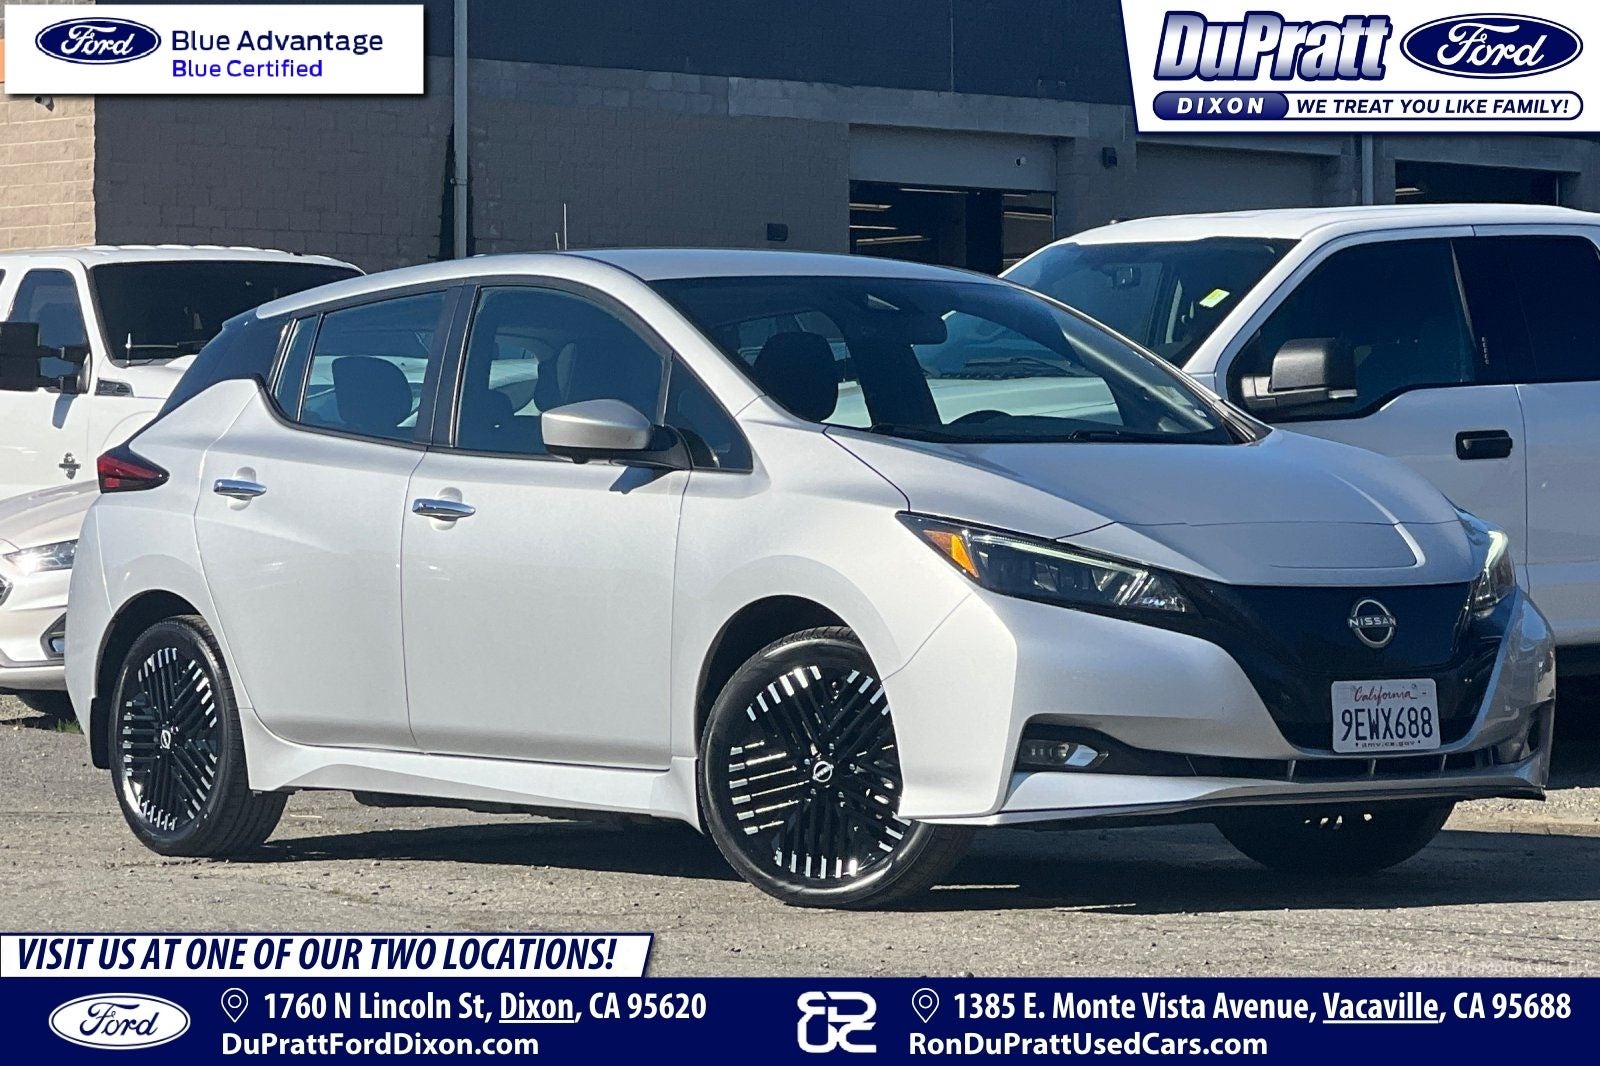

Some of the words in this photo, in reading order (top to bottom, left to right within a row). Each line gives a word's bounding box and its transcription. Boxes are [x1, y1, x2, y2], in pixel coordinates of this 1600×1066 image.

[1349, 616, 1397, 627] NISSAN
[1354, 686, 1418, 706] California
[1341, 706, 1433, 741] 9EWX688
